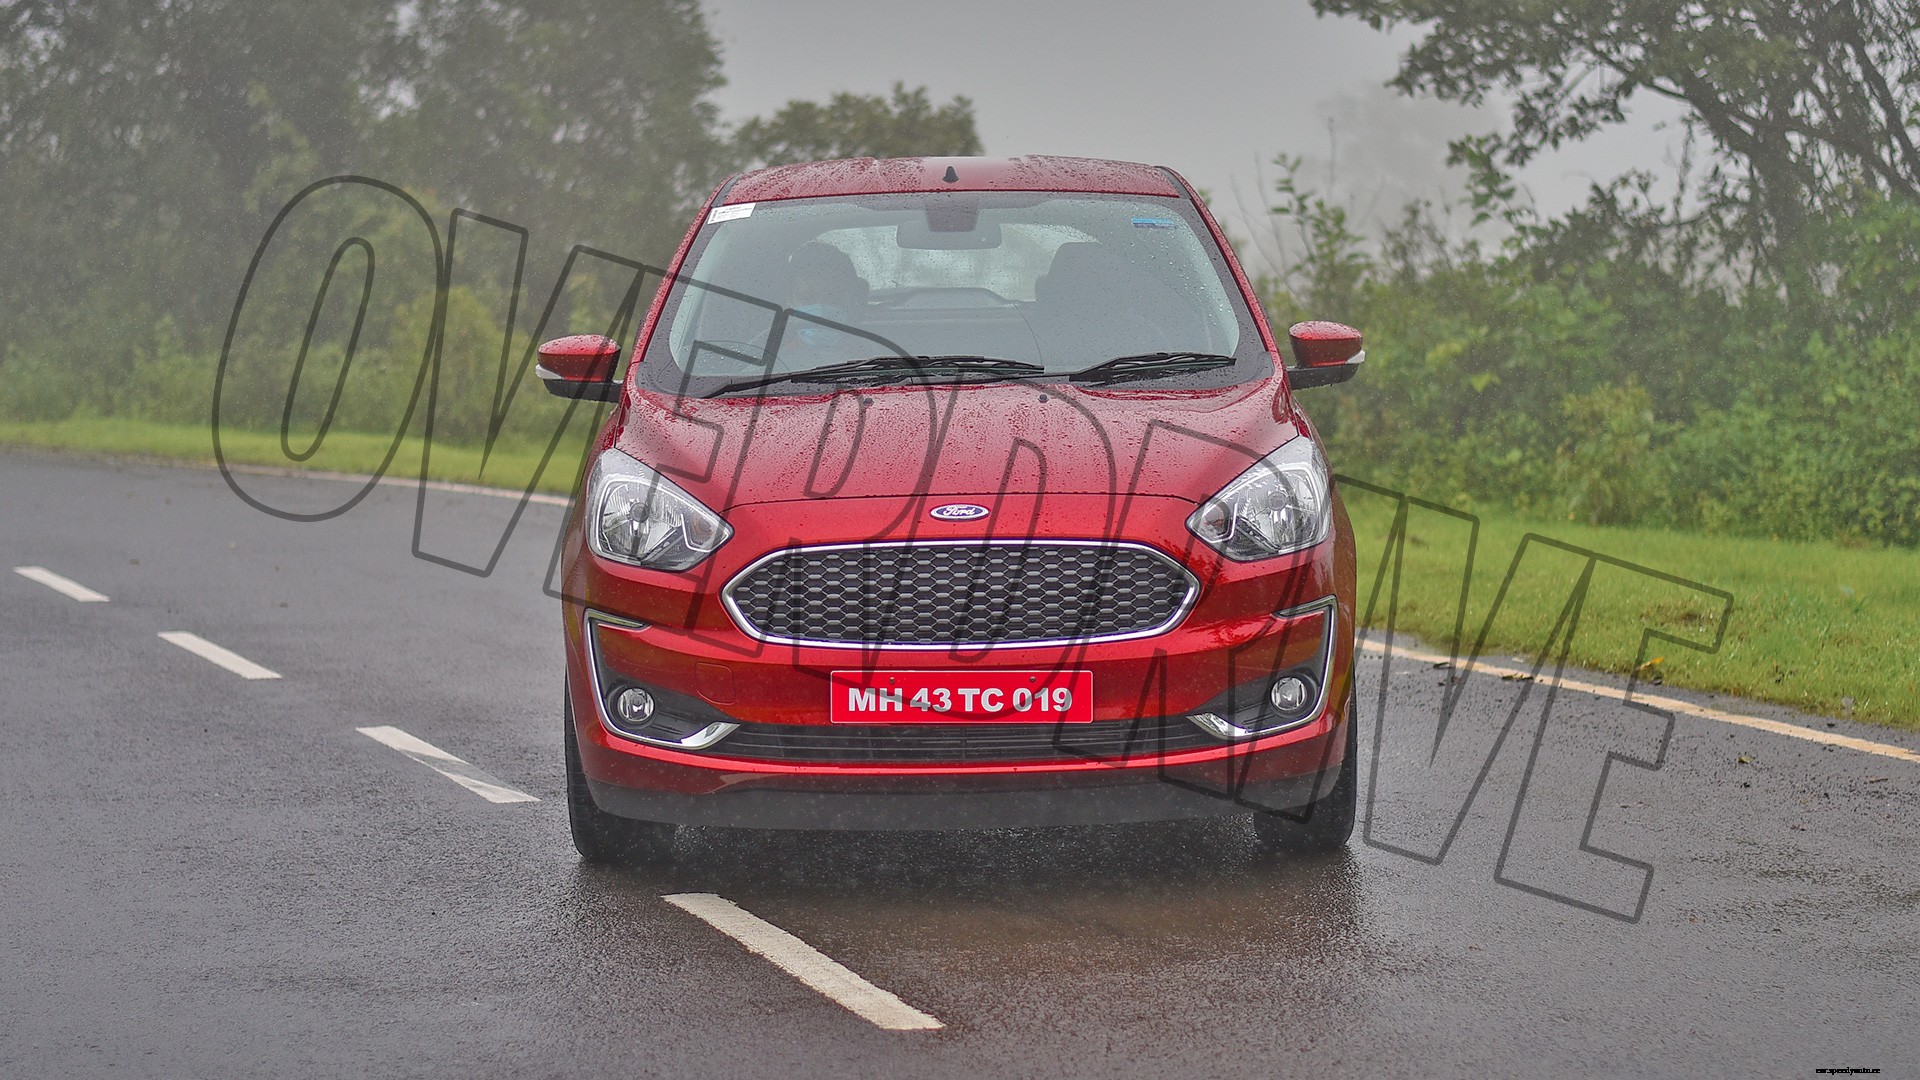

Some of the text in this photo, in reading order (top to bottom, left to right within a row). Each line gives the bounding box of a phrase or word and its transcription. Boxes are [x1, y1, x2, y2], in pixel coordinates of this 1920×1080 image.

[942, 504, 976, 516] Ford
[848, 687, 1073, 712] MH 43 TC 019
